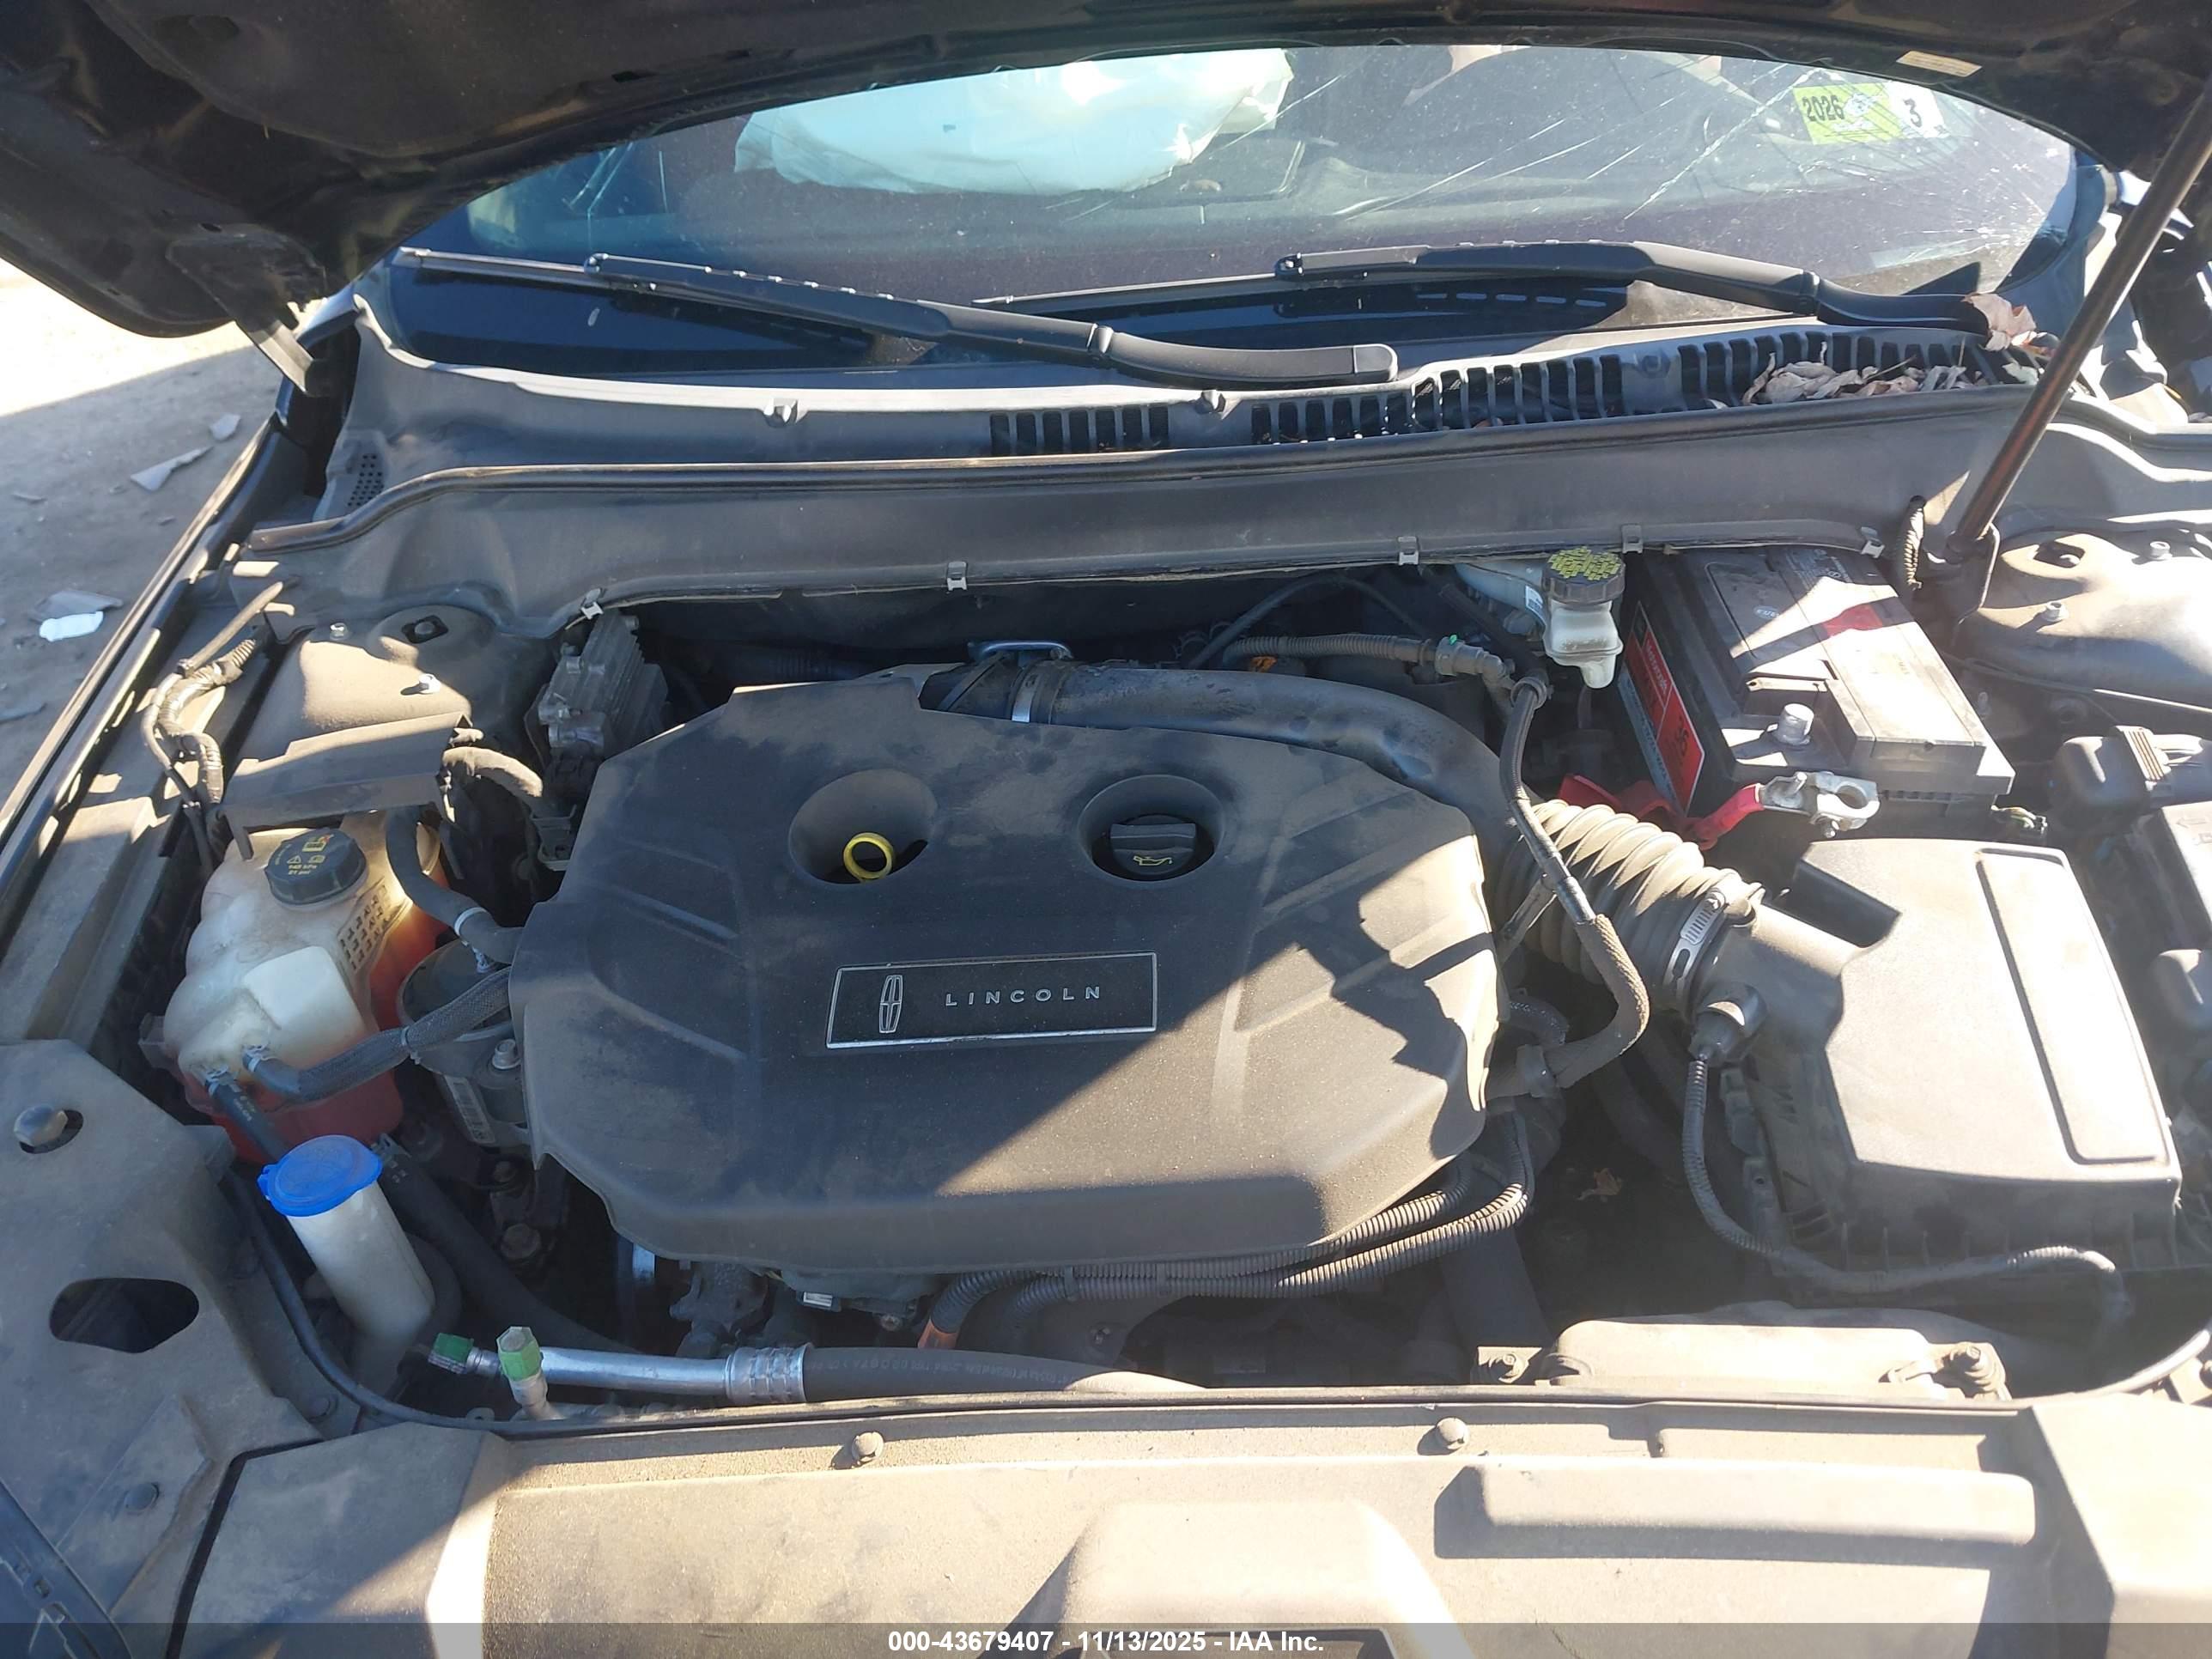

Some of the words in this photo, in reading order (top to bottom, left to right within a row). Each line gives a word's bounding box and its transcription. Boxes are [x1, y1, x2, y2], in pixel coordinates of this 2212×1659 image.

[1803, 95, 1845, 121] 2026
[1903, 98, 1923, 128] 3
[945, 985, 1101, 1006] LINCOLN
